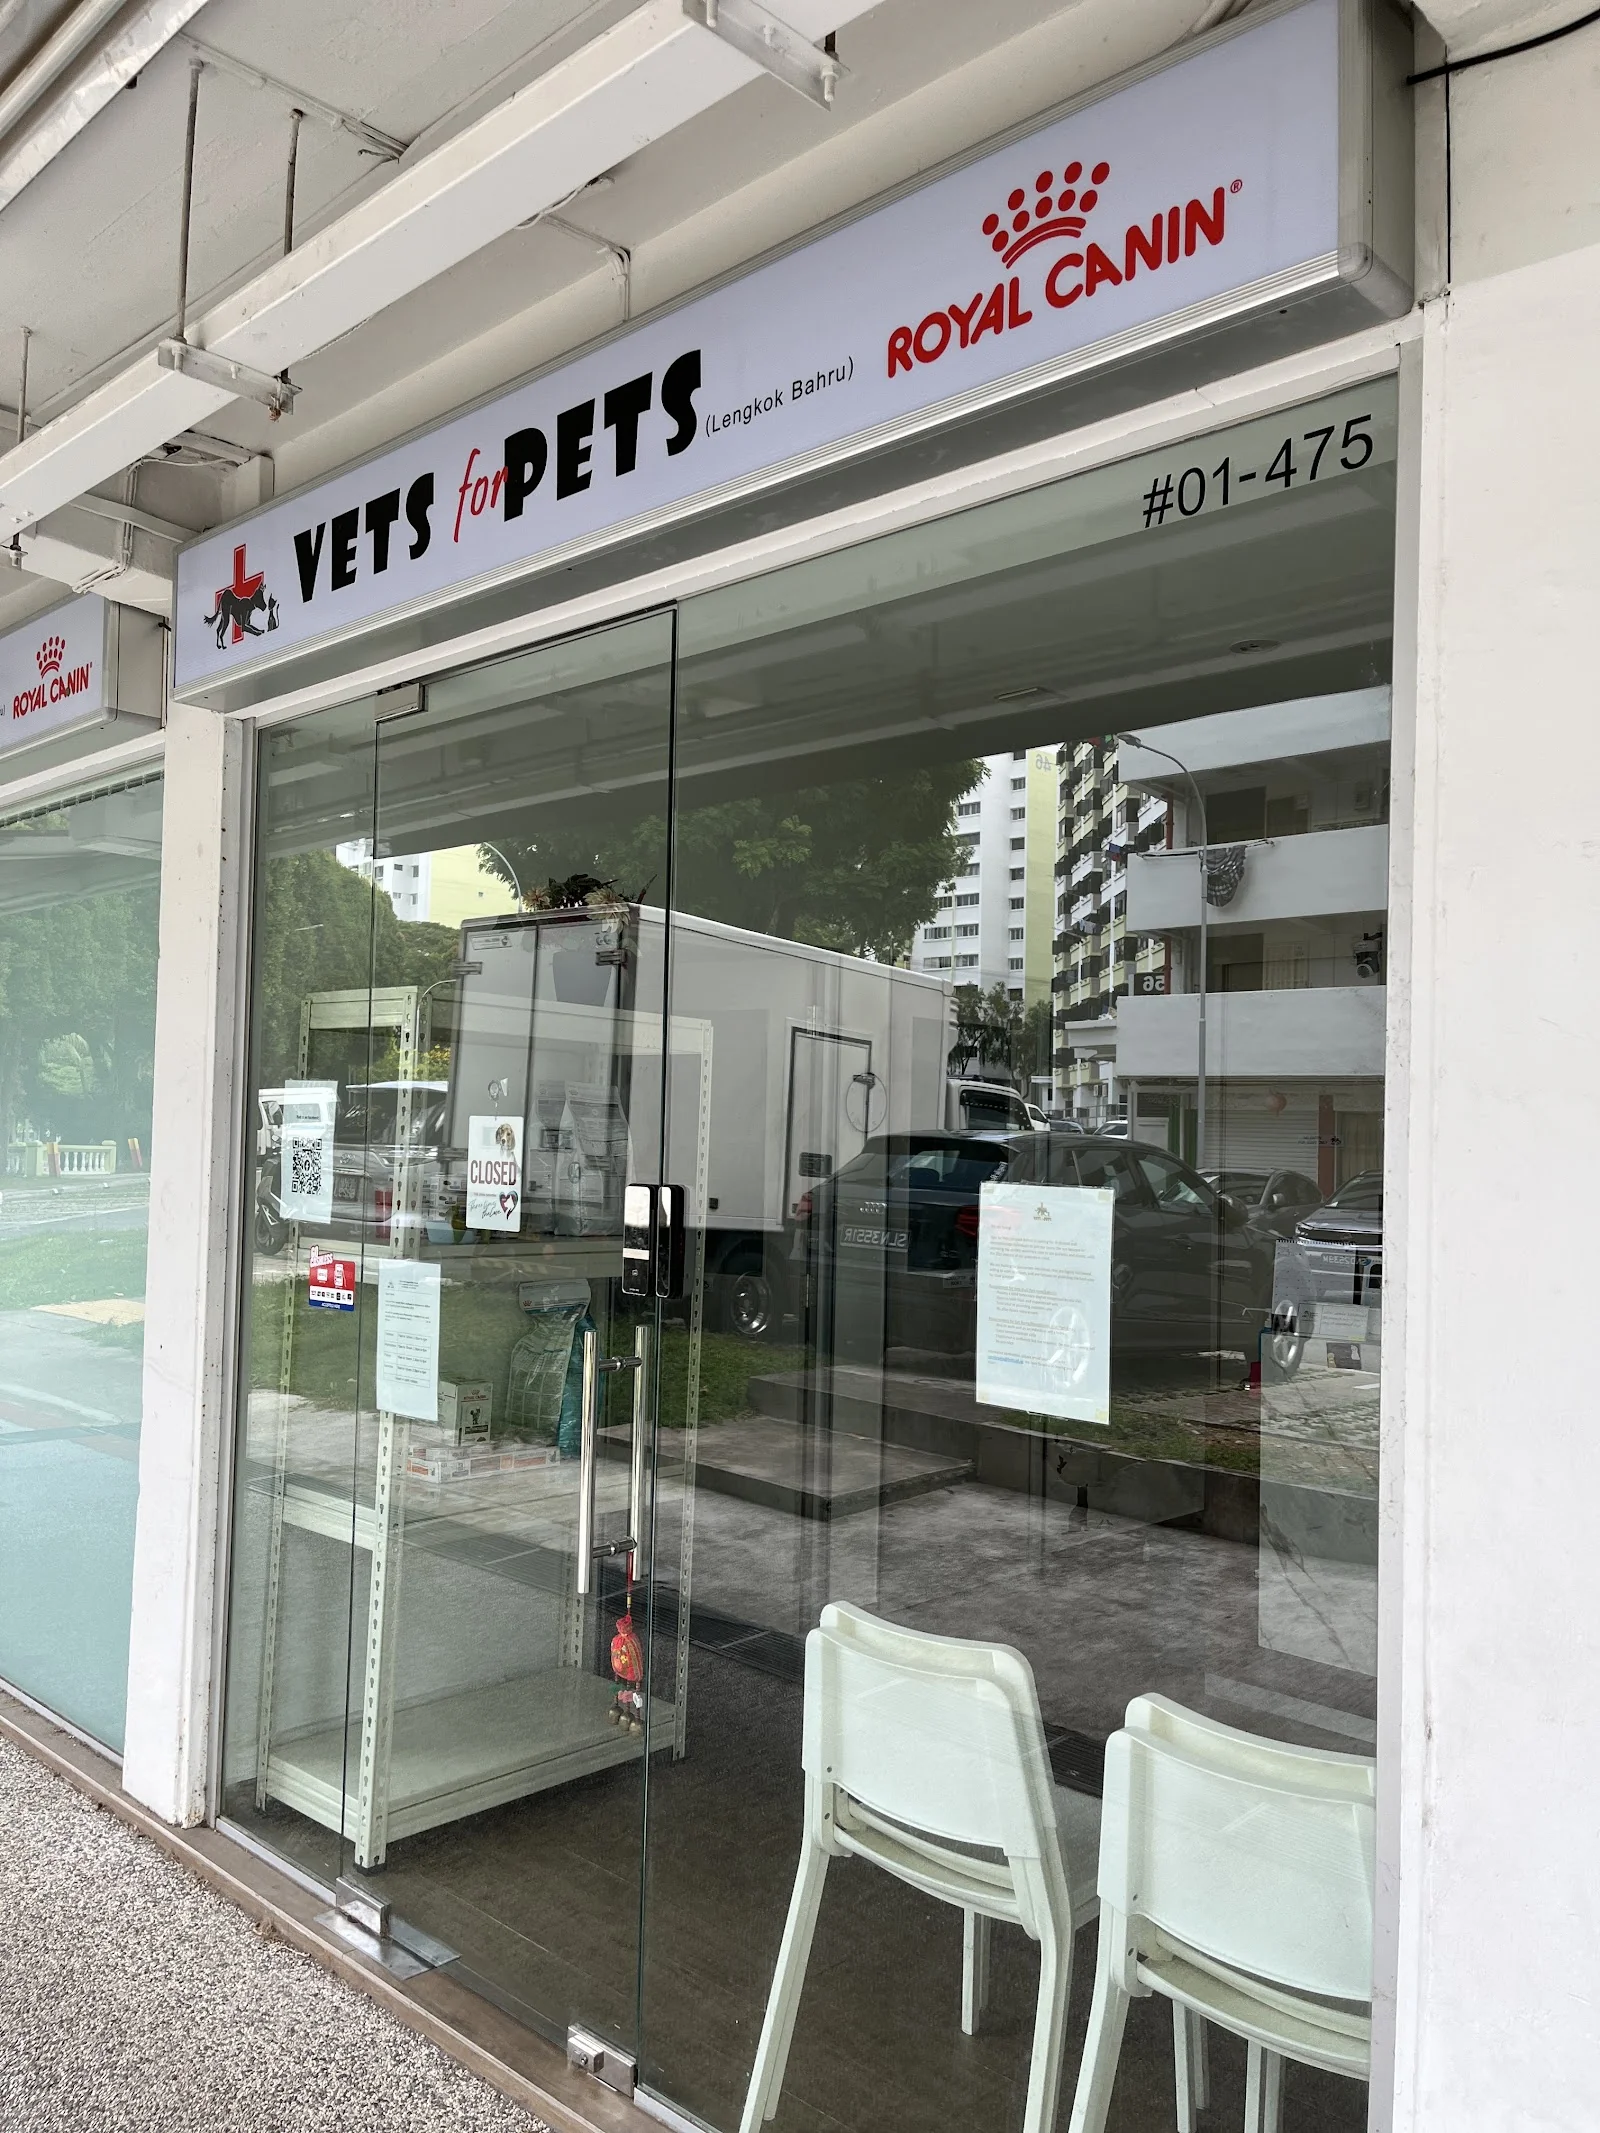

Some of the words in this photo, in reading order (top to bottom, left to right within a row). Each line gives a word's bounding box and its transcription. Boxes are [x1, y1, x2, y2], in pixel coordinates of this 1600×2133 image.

[887, 276, 1032, 378] ROYAL
[705, 389, 784, 438] (Lengkok
[791, 355, 855, 402] Bahru)
[293, 471, 435, 603] VETS
[453, 448, 509, 543] for
[503, 349, 703, 523] PETS
[1142, 414, 1374, 529] #01-475
[13, 683, 48, 719] ROYAL
[49, 663, 89, 703] CANIN
[470, 1159, 517, 1186] CLOSED
